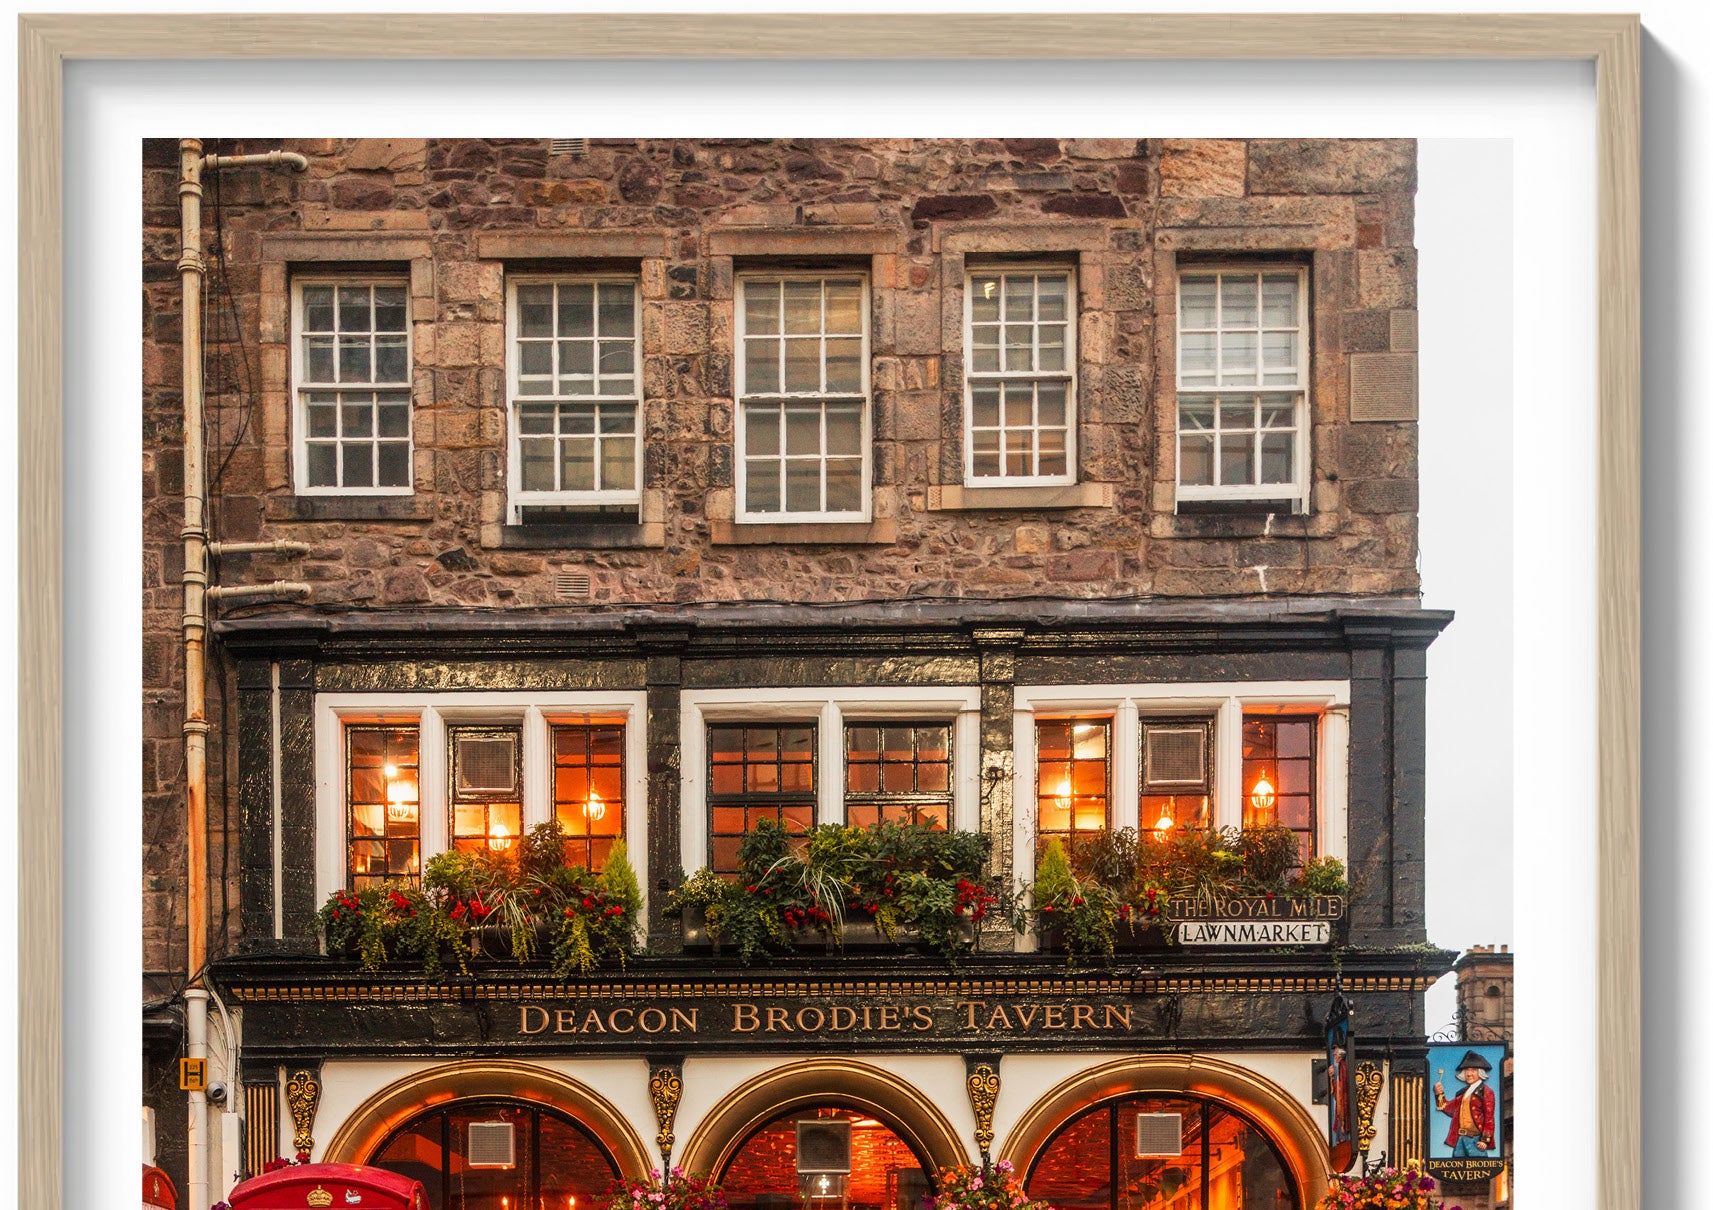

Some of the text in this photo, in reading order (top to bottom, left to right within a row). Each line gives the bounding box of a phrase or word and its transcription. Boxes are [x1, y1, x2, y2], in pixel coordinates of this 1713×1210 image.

[1171, 899, 1338, 917] THE ROYAL MILE
[1183, 924, 1325, 942] LAWNMARKET
[517, 1001, 1132, 1034] DEACON BRODIE'S TAVERN
[1429, 1160, 1503, 1169] DEACON BRODIE'S
[1441, 1170, 1490, 1180] TAVERN
